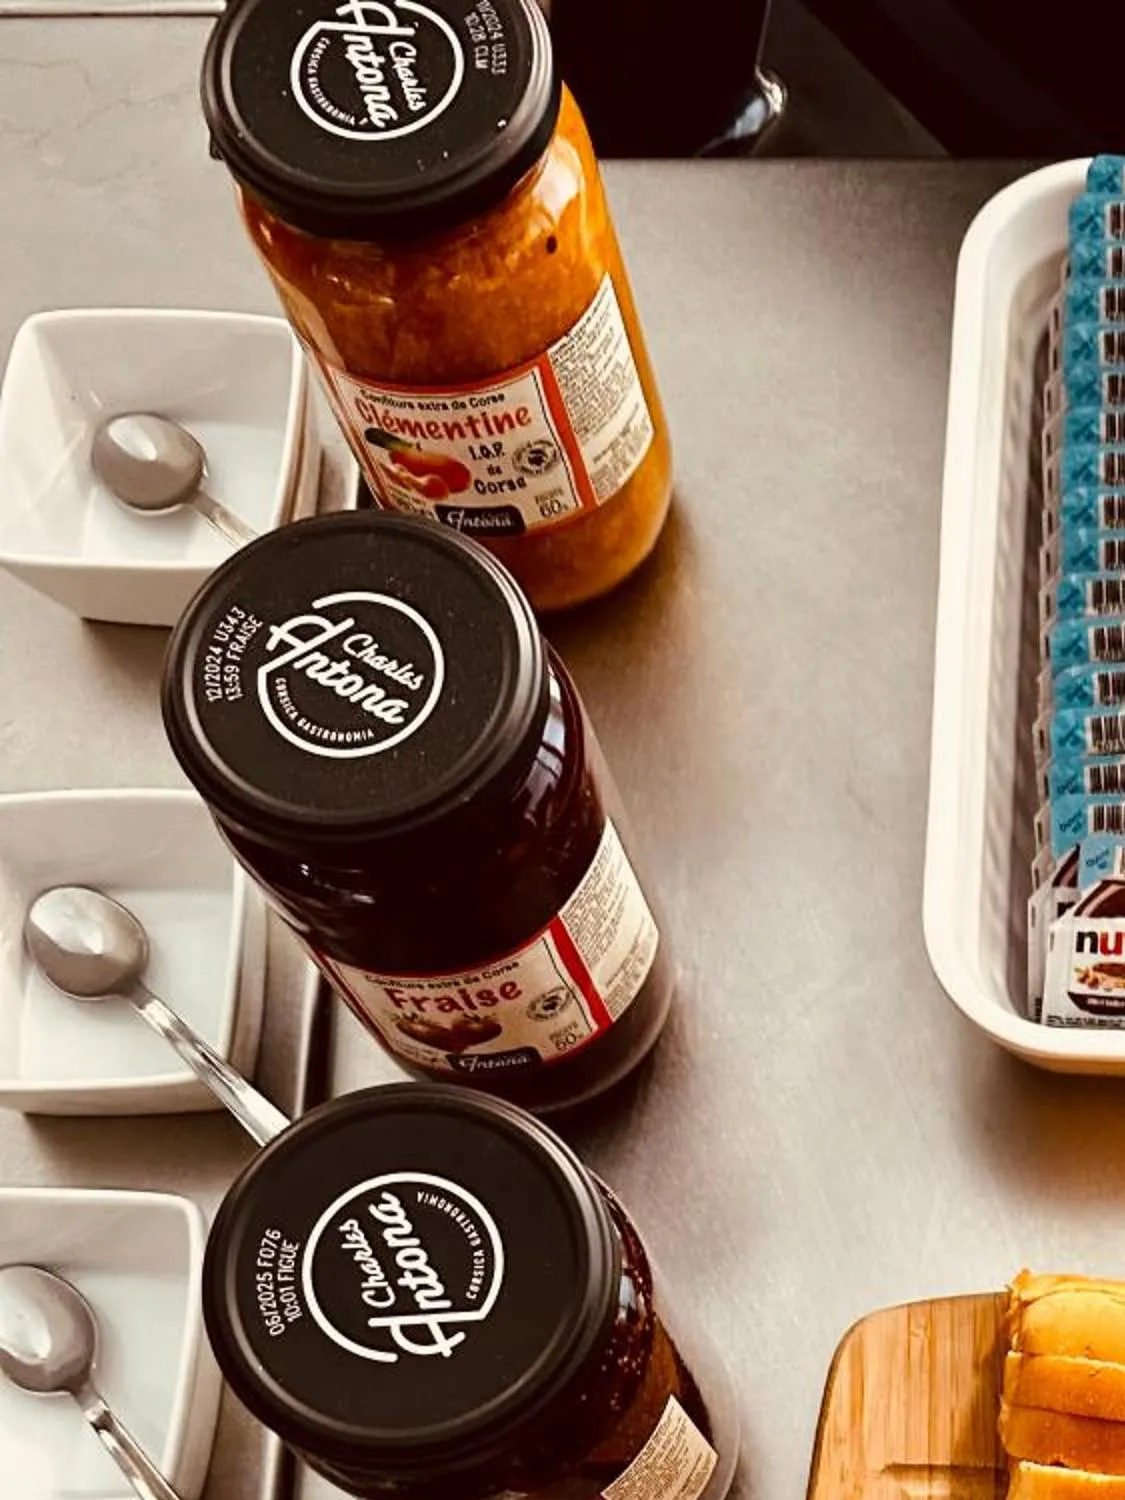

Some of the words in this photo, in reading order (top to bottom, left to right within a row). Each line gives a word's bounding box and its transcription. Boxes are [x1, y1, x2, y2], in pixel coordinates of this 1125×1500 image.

[388, 41, 428, 111] Charles
[353, 397, 532, 442] Clémentine
[473, 477, 527, 497] Corse
[229, 614, 263, 660] FRAISE
[343, 633, 424, 690] Charles
[204, 647, 223, 702] 12/2024
[266, 614, 408, 725] Antona
[383, 980, 522, 1013] Fraise
[257, 1228, 281, 1268] F076
[277, 1239, 300, 1282] FIGUE
[339, 1218, 396, 1308] Charles
[368, 1191, 466, 1358] Antona
[256, 1272, 285, 1337] 06/2025
